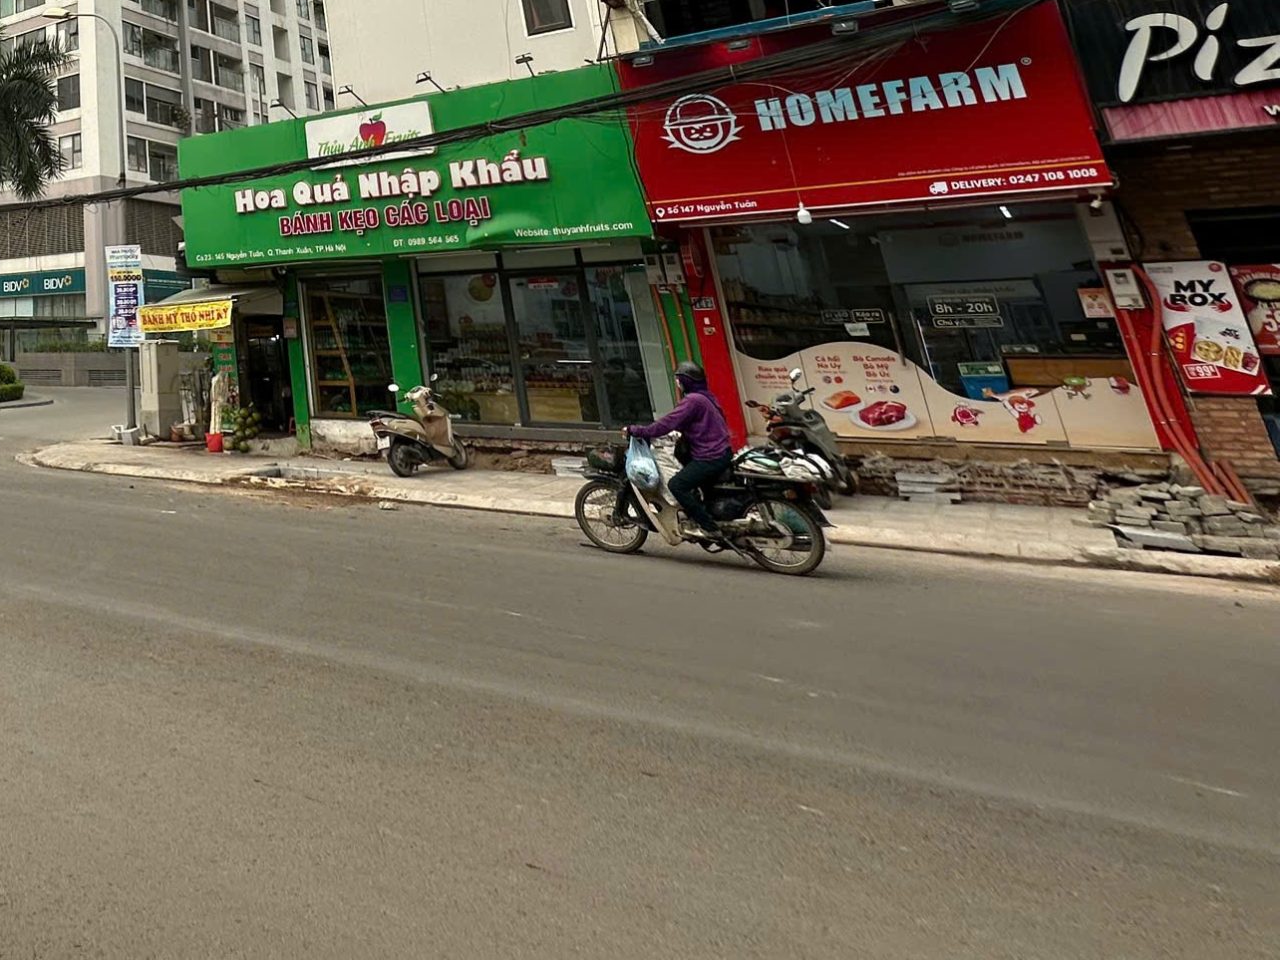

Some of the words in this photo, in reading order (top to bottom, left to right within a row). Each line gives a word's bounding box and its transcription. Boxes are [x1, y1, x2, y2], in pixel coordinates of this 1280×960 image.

[755, 63, 1027, 131] HOMEFARM
[384, 129, 421, 145] Fruits
[234, 188, 286, 213] Hoa
[293, 173, 351, 206] Quả
[358, 167, 440, 202] Nhập
[449, 149, 549, 189] Khẩu
[951, 177, 1006, 190] DELIVERY:
[1009, 173, 1039, 185] 0247
[1043, 171, 1065, 181] 108
[1069, 167, 1098, 179] 1008
[667, 205, 678, 214] Số
[680, 204, 694, 213] 147
[697, 201, 732, 214] Nguyễn
[279, 208, 333, 236] BÁNH
[338, 207, 378, 236] KẸO
[384, 199, 429, 226] CÁC
[436, 196, 491, 227] LOẠI
[514, 227, 551, 238] Website:
[552, 221, 633, 239] thuyanhfruits.com
[3, 281, 22, 292] BIDV
[43, 278, 64, 289] BIDV
[1174, 279, 1216, 293] MY
[1169, 292, 1227, 307] BOX
[935, 303, 952, 314] 8h
[966, 303, 993, 313] 20h
